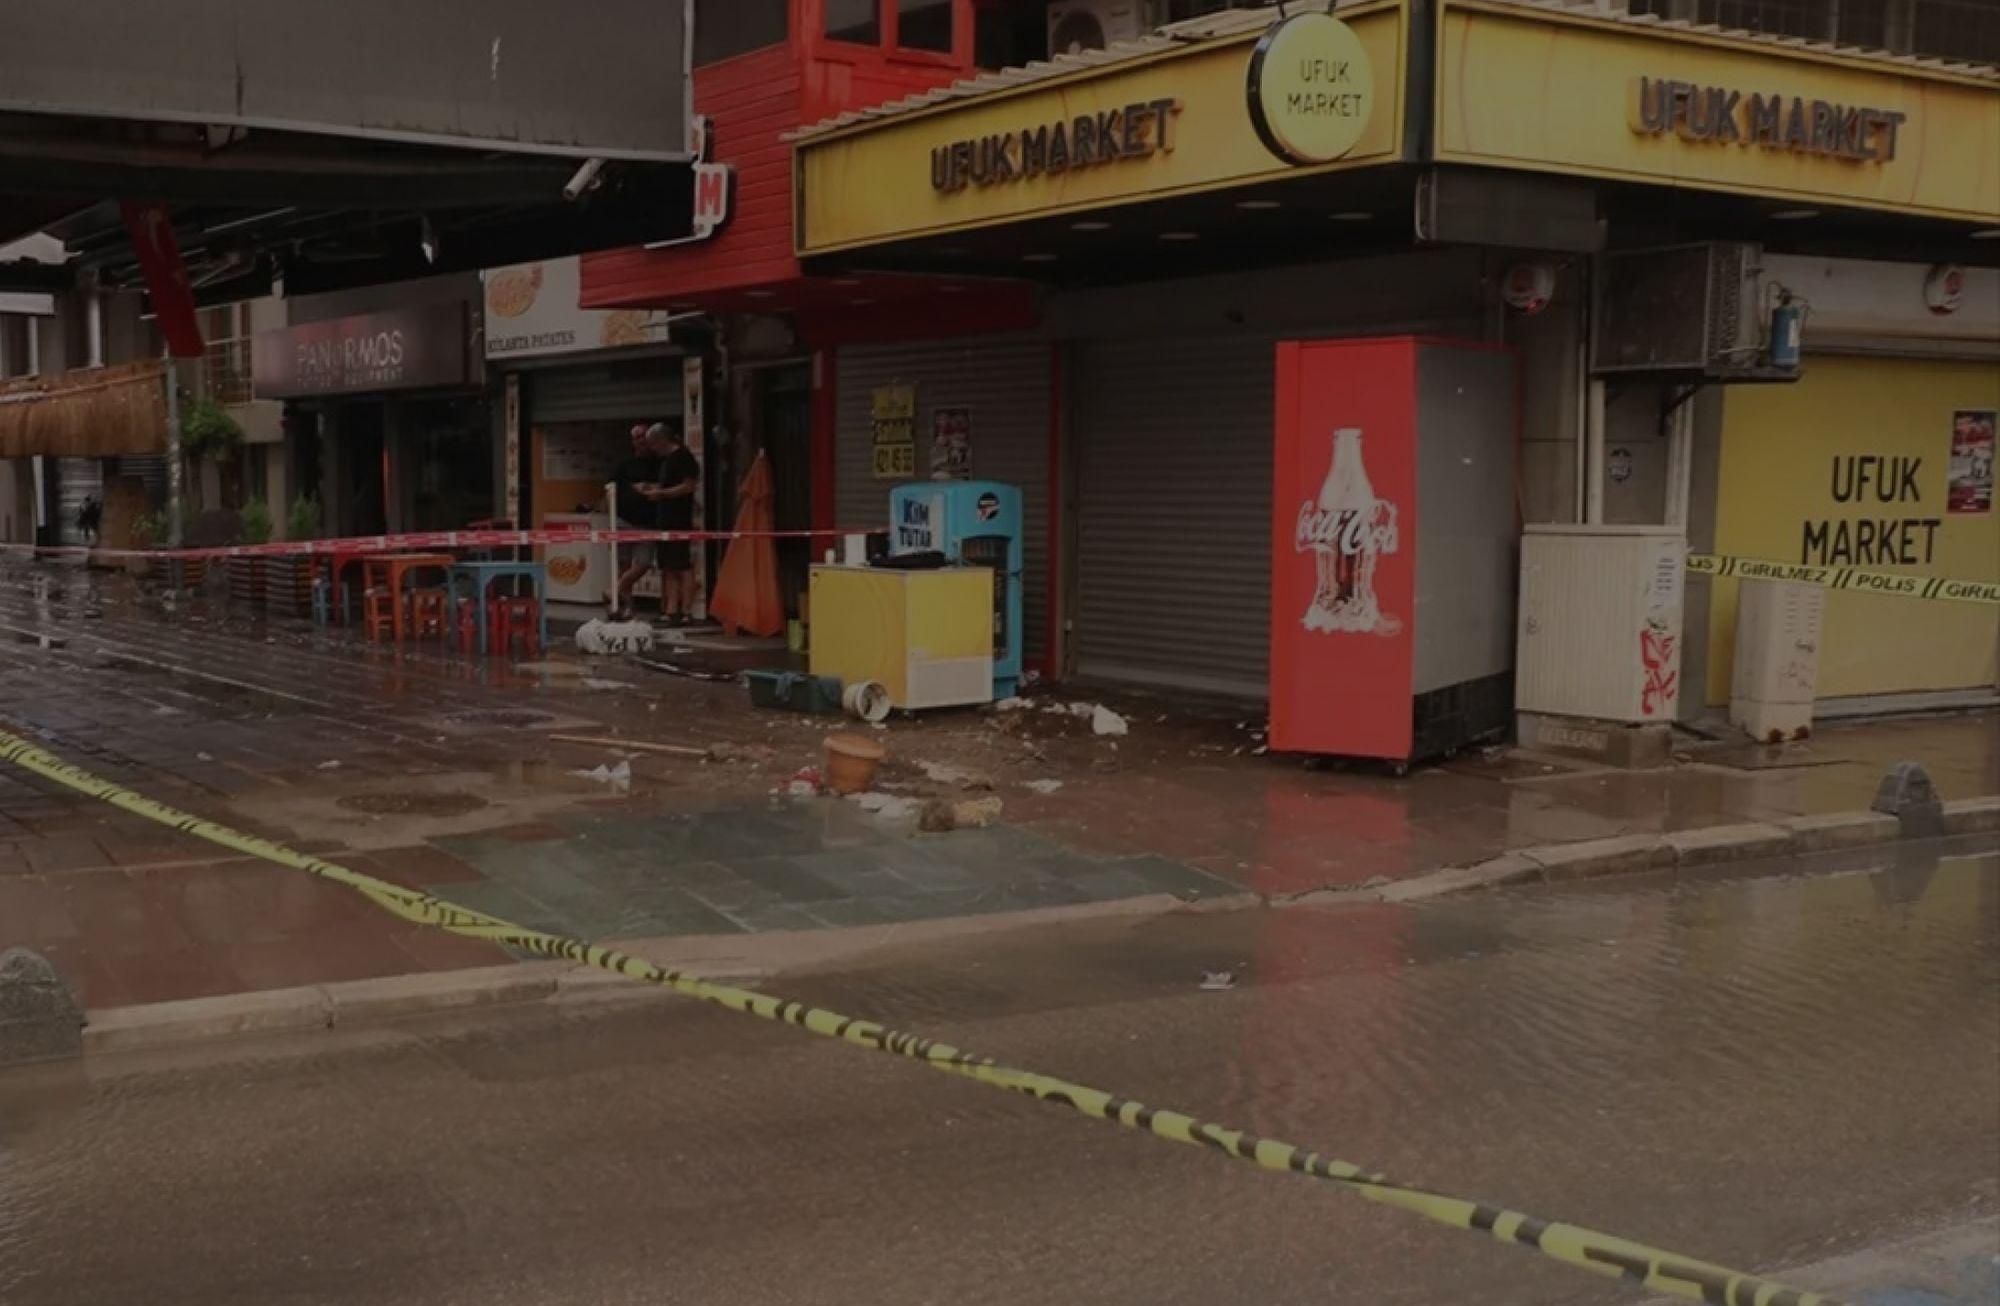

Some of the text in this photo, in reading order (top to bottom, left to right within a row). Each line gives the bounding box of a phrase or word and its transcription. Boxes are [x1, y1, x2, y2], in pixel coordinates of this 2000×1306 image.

[1300, 58, 1350, 83] UFUK
[1287, 92, 1363, 117] MARKET
[1640, 76, 1906, 162] UFUK MARKET
[931, 98, 1177, 190] UFUK MARKET
[1831, 455, 1922, 503] UFUK
[1800, 518, 1942, 565] MARKET
